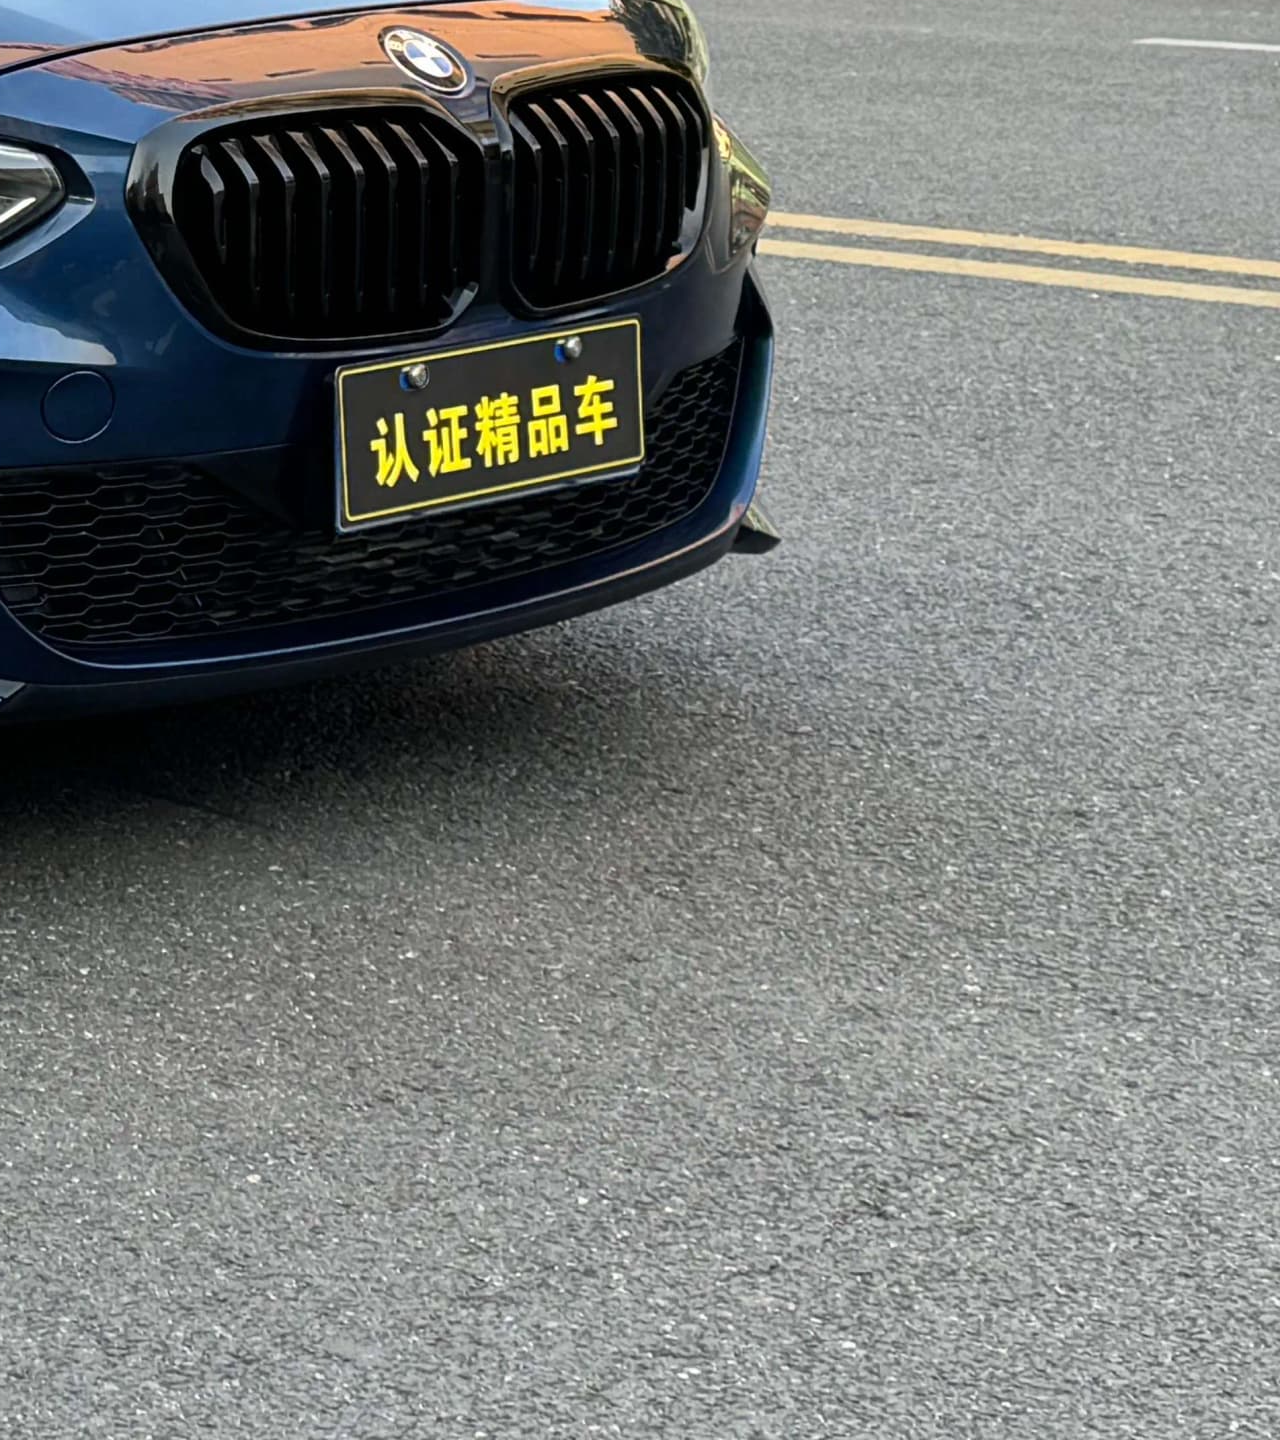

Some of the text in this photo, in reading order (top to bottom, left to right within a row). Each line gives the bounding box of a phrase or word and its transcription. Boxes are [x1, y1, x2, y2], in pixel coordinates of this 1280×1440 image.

[370, 374, 618, 488] 认证精品车
